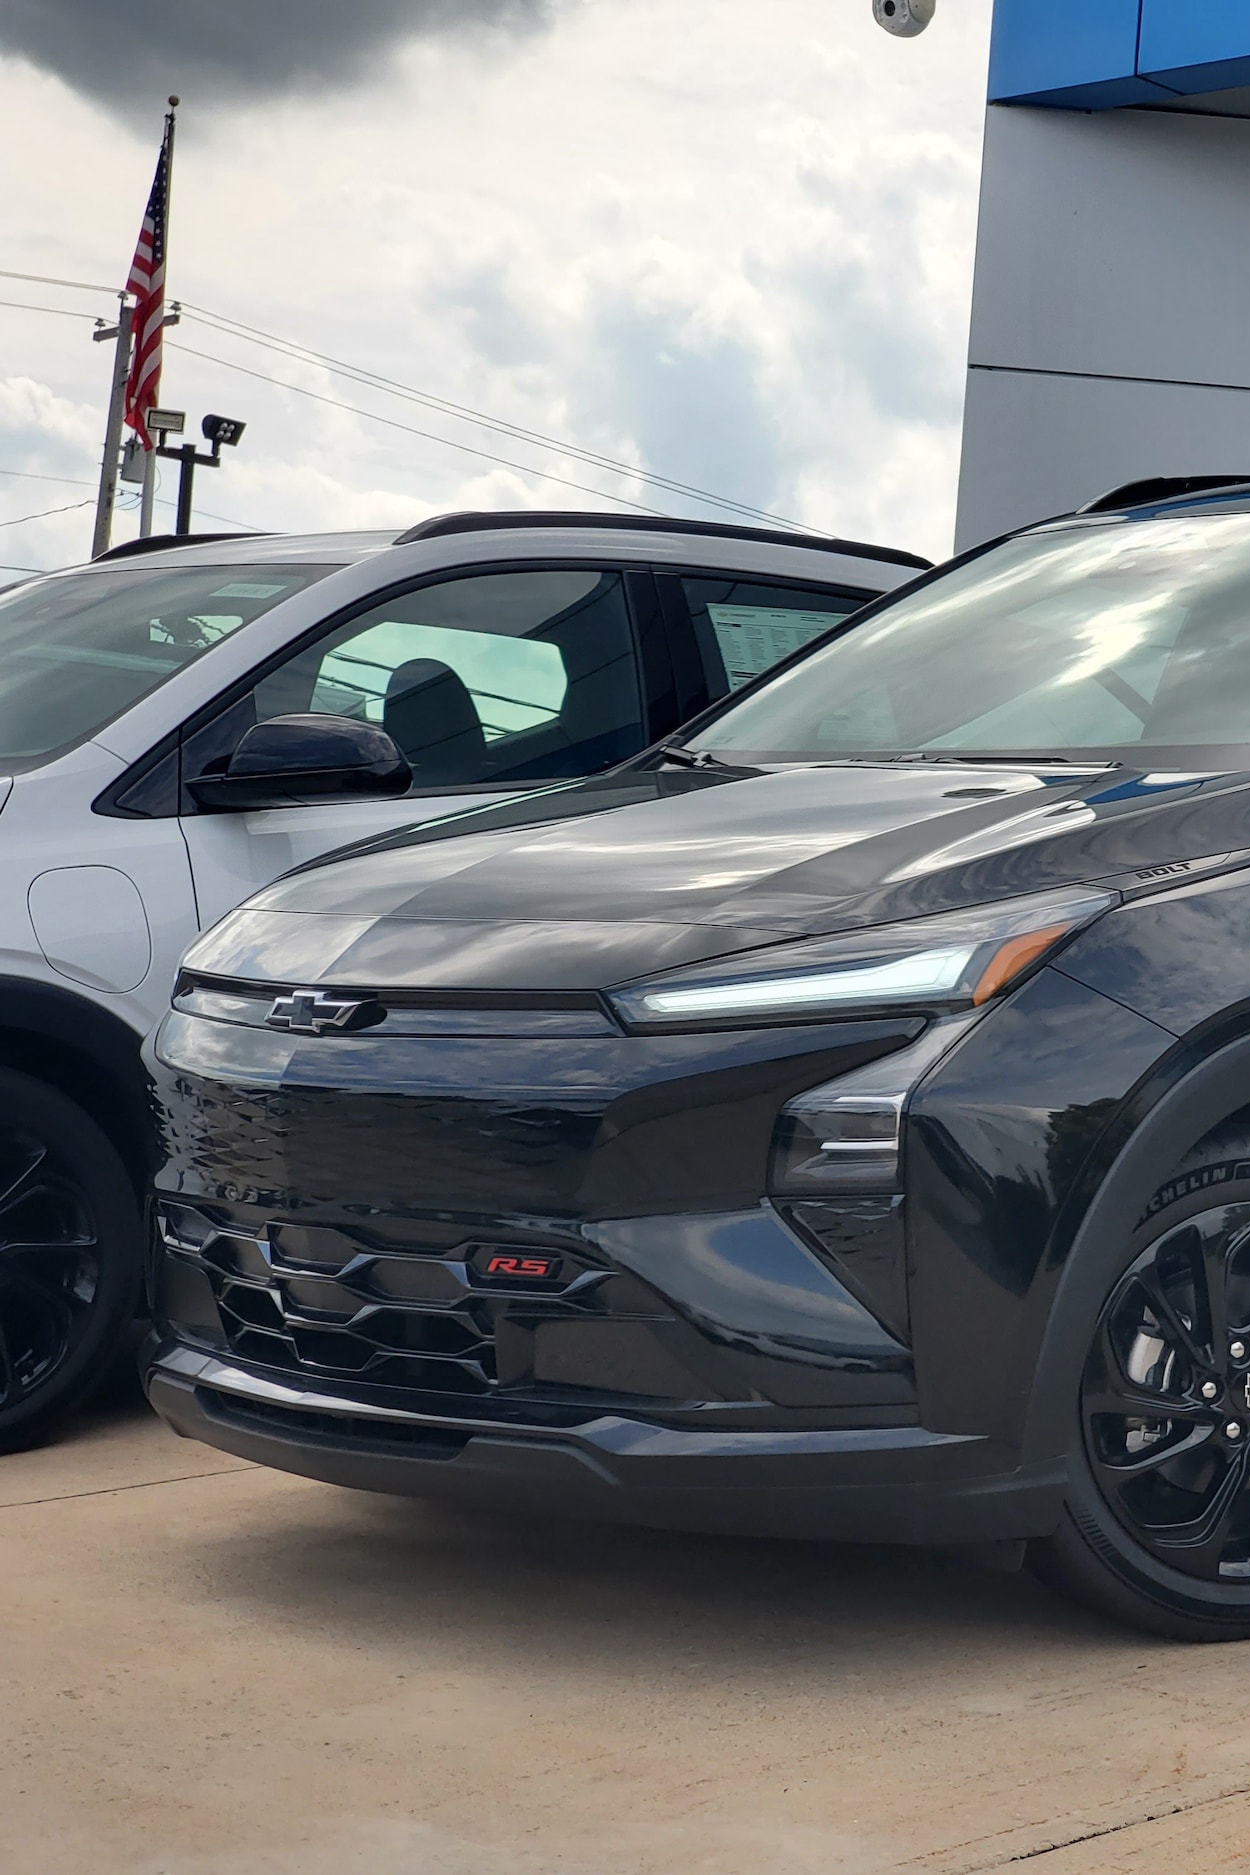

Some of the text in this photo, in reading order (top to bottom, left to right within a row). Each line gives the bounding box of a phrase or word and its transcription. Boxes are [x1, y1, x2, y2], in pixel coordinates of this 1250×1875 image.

[1135, 862, 1191, 880] BOLT
[1147, 1167, 1227, 1212] CHELIN
[487, 1257, 549, 1276] RS
